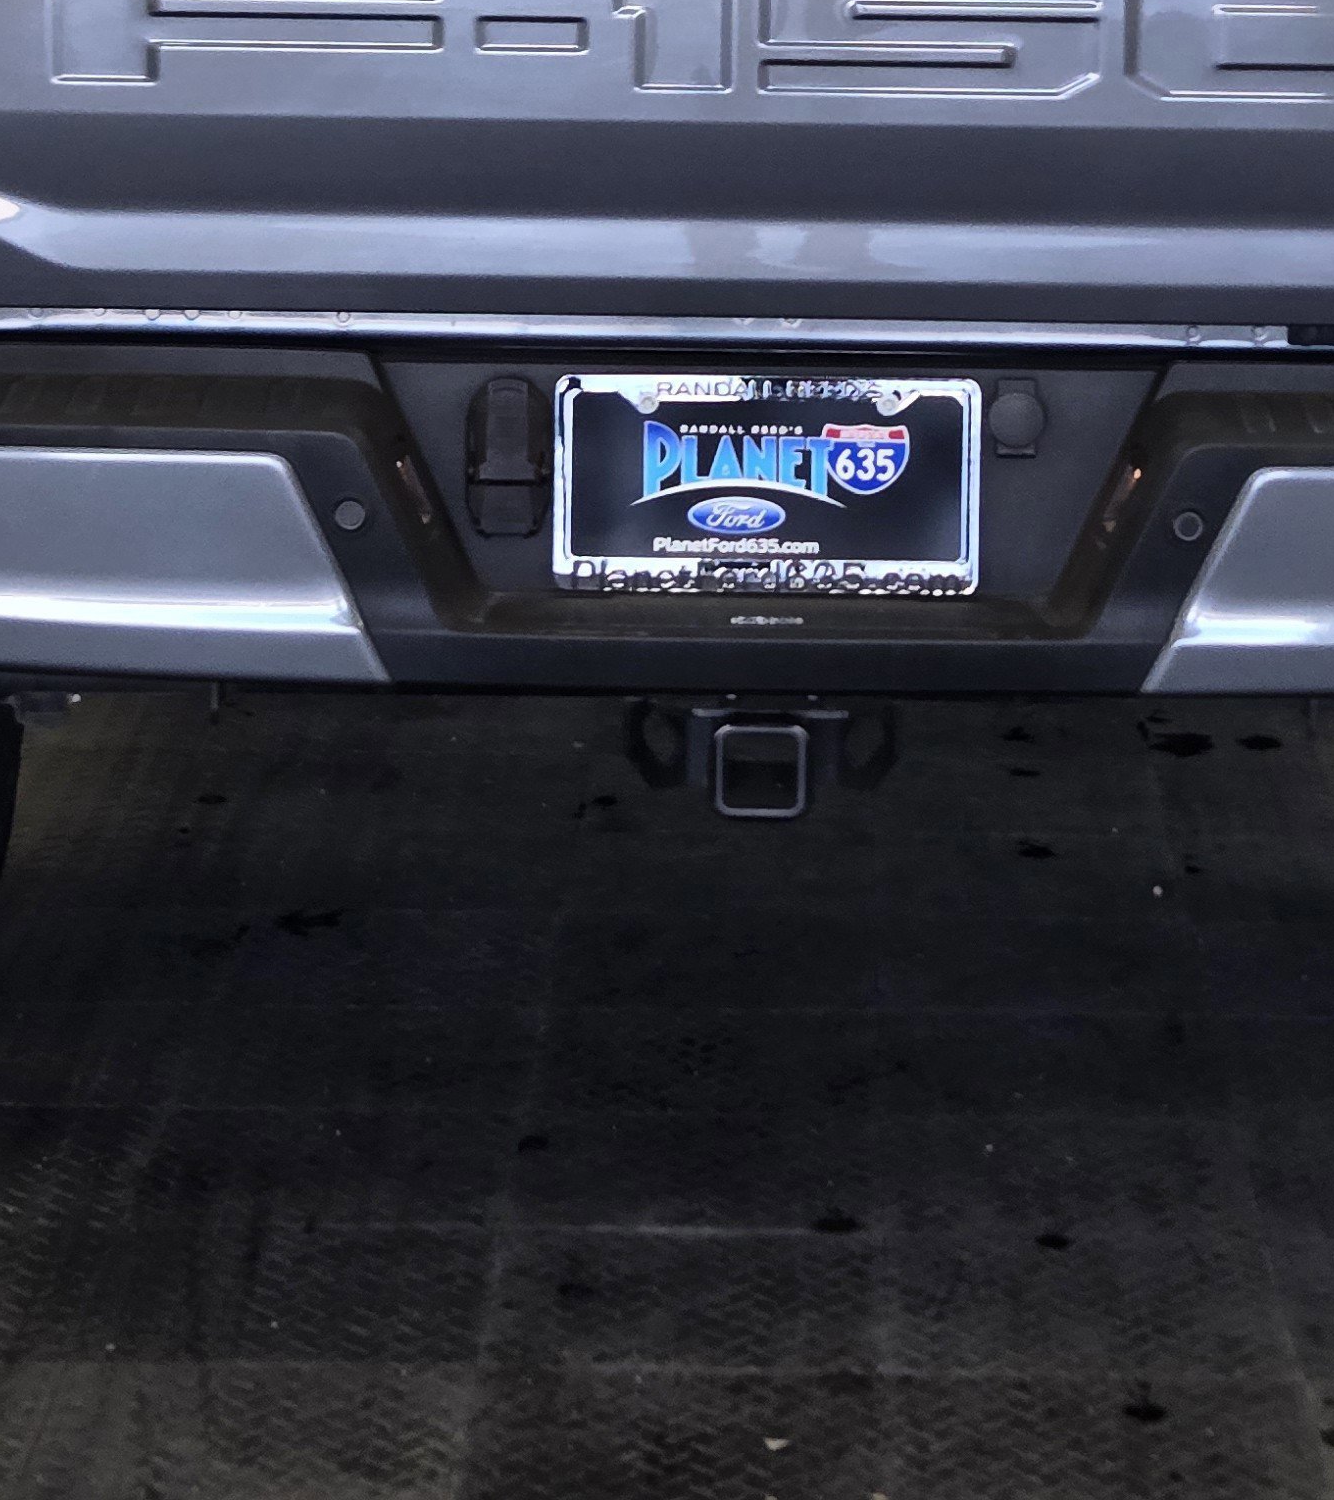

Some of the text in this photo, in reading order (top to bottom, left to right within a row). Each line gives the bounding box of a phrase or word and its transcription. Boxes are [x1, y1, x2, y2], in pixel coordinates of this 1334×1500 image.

[643, 420, 896, 498] PLANET 635
[705, 502, 768, 530] Ford
[652, 536, 820, 555] PlanetFord635.com
